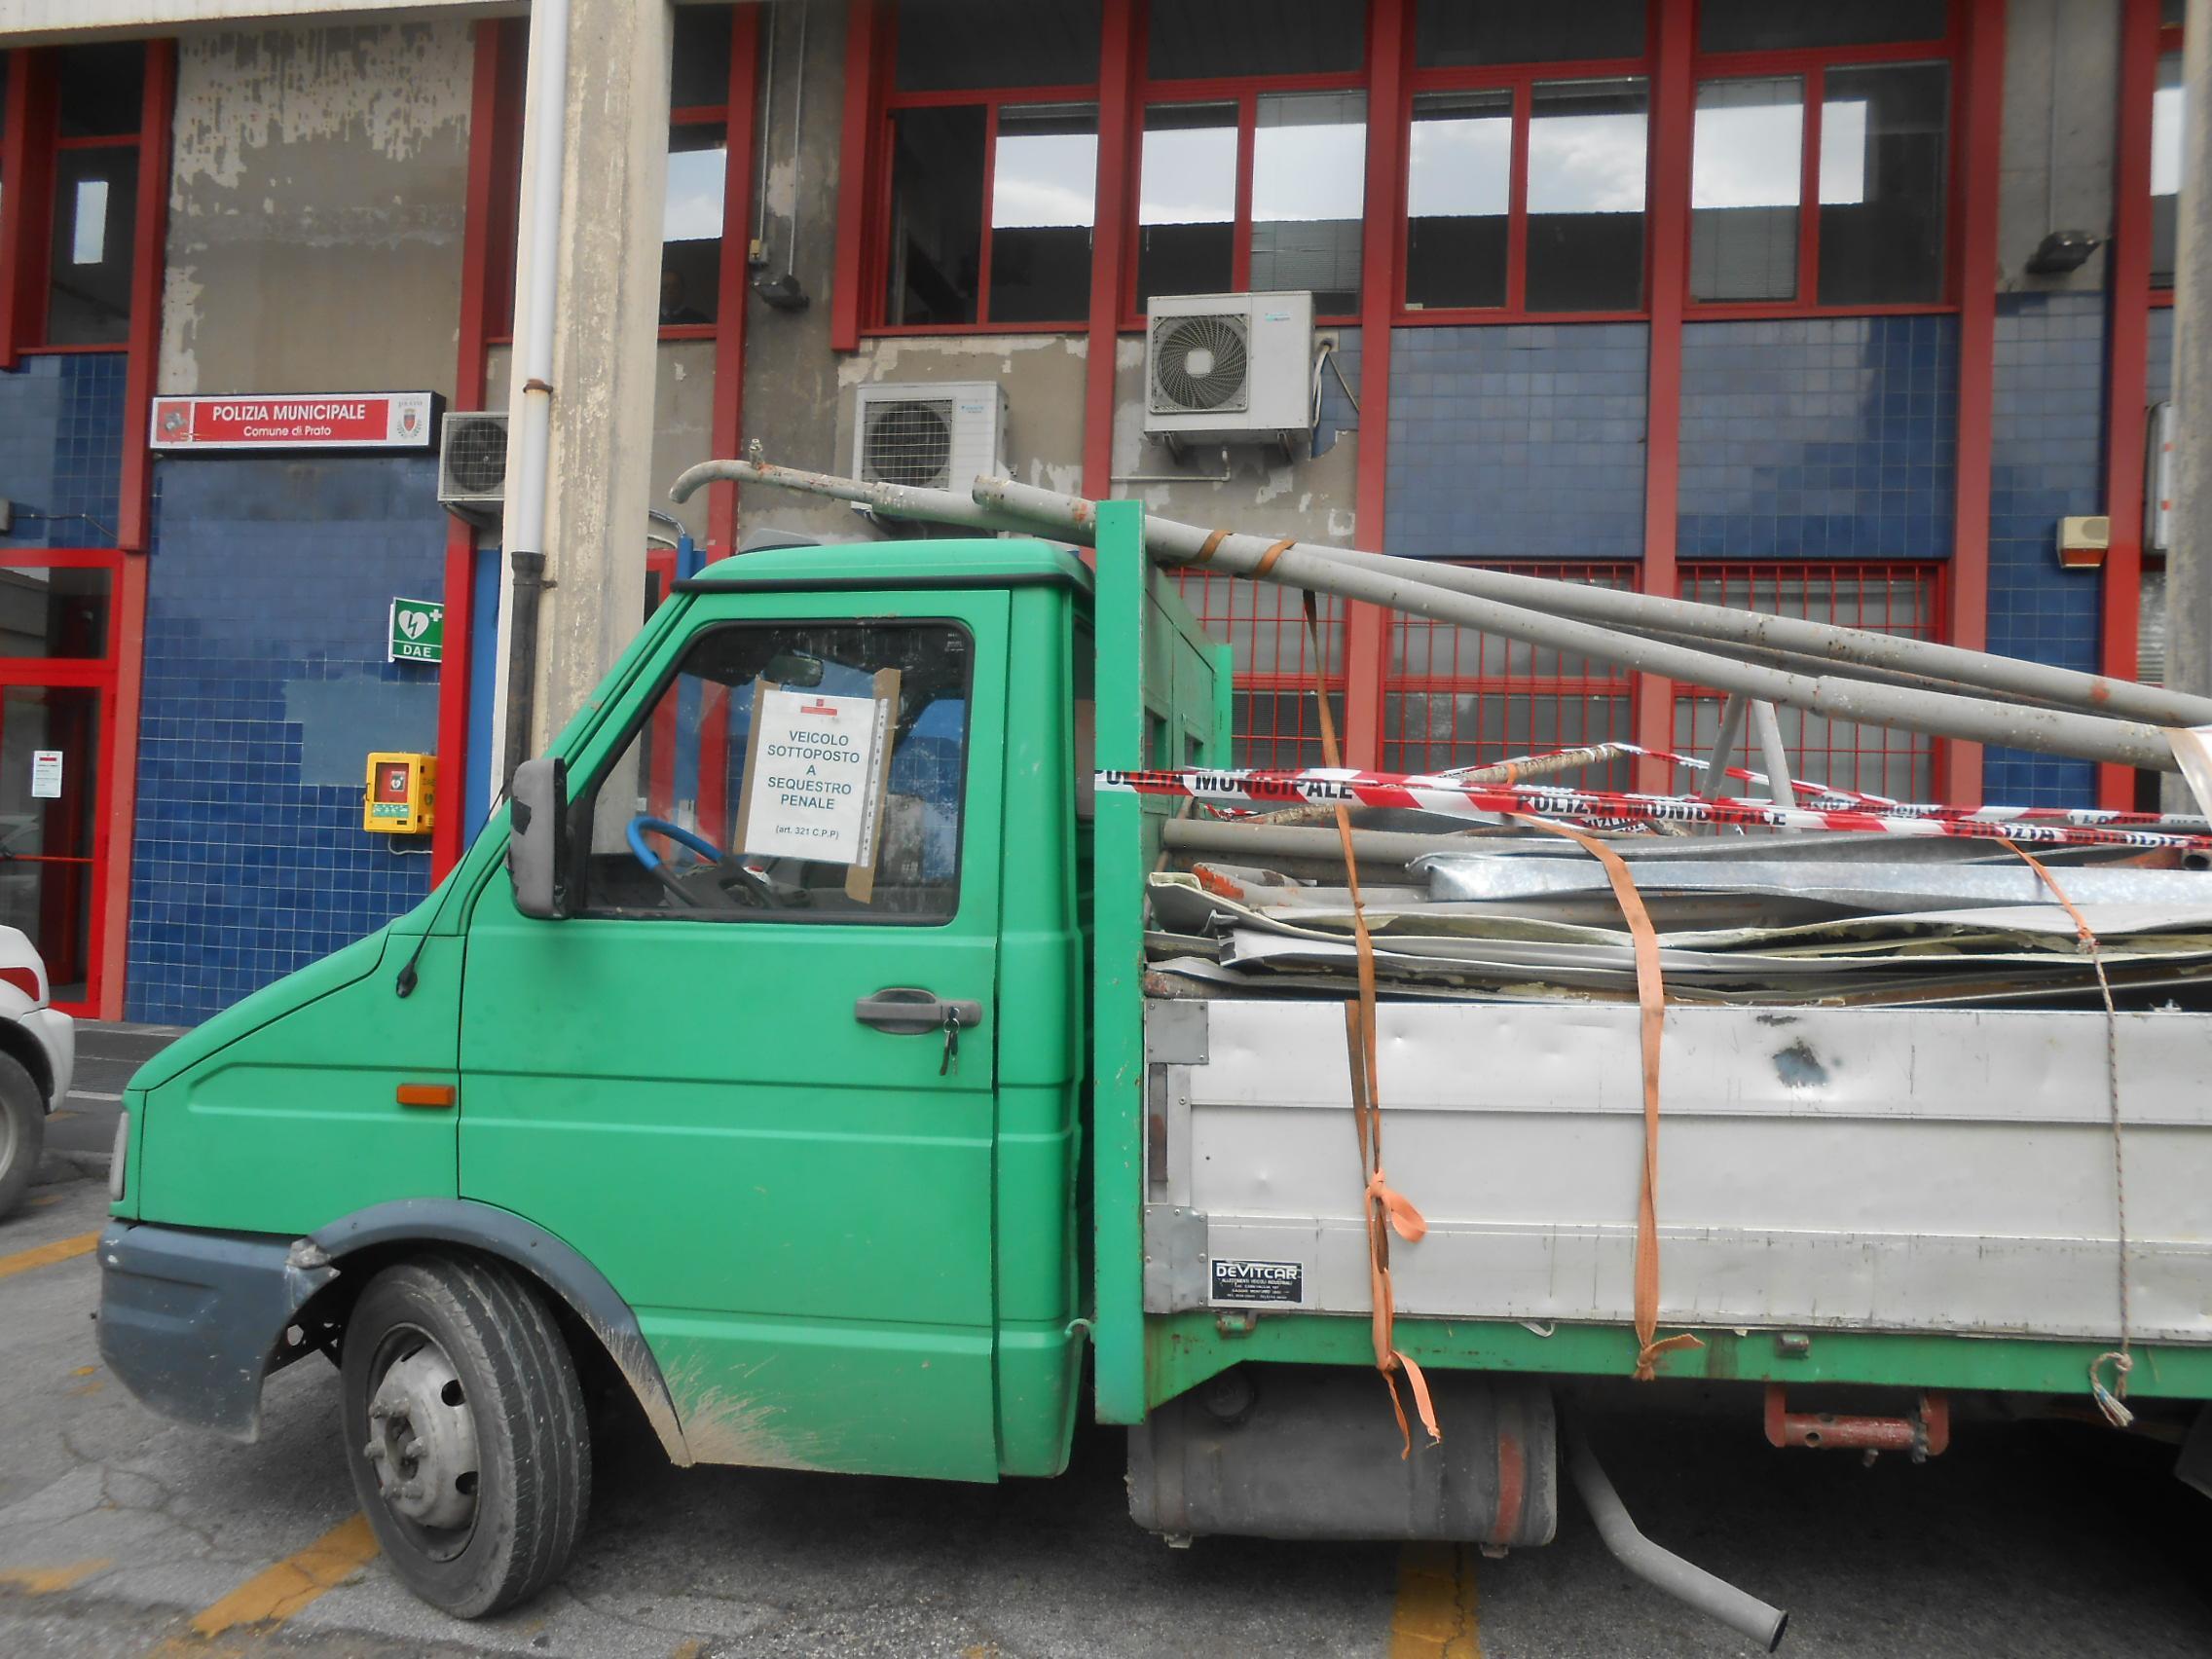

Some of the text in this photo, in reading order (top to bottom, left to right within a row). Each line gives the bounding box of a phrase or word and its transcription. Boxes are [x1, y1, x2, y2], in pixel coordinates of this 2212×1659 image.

[212, 404, 365, 422] POLIZIA MUNICIPALE
[243, 424, 331, 437] Comune di Prato
[402, 644, 432, 658] DAE
[789, 730, 849, 746] VEICOLO
[767, 744, 860, 763] SOTTOPOSTO
[806, 764, 816, 776] A
[767, 776, 852, 795] SEQUESTRO
[781, 793, 835, 810] PENALE
[776, 825, 793, 834] (art.
[794, 827, 810, 835] 321
